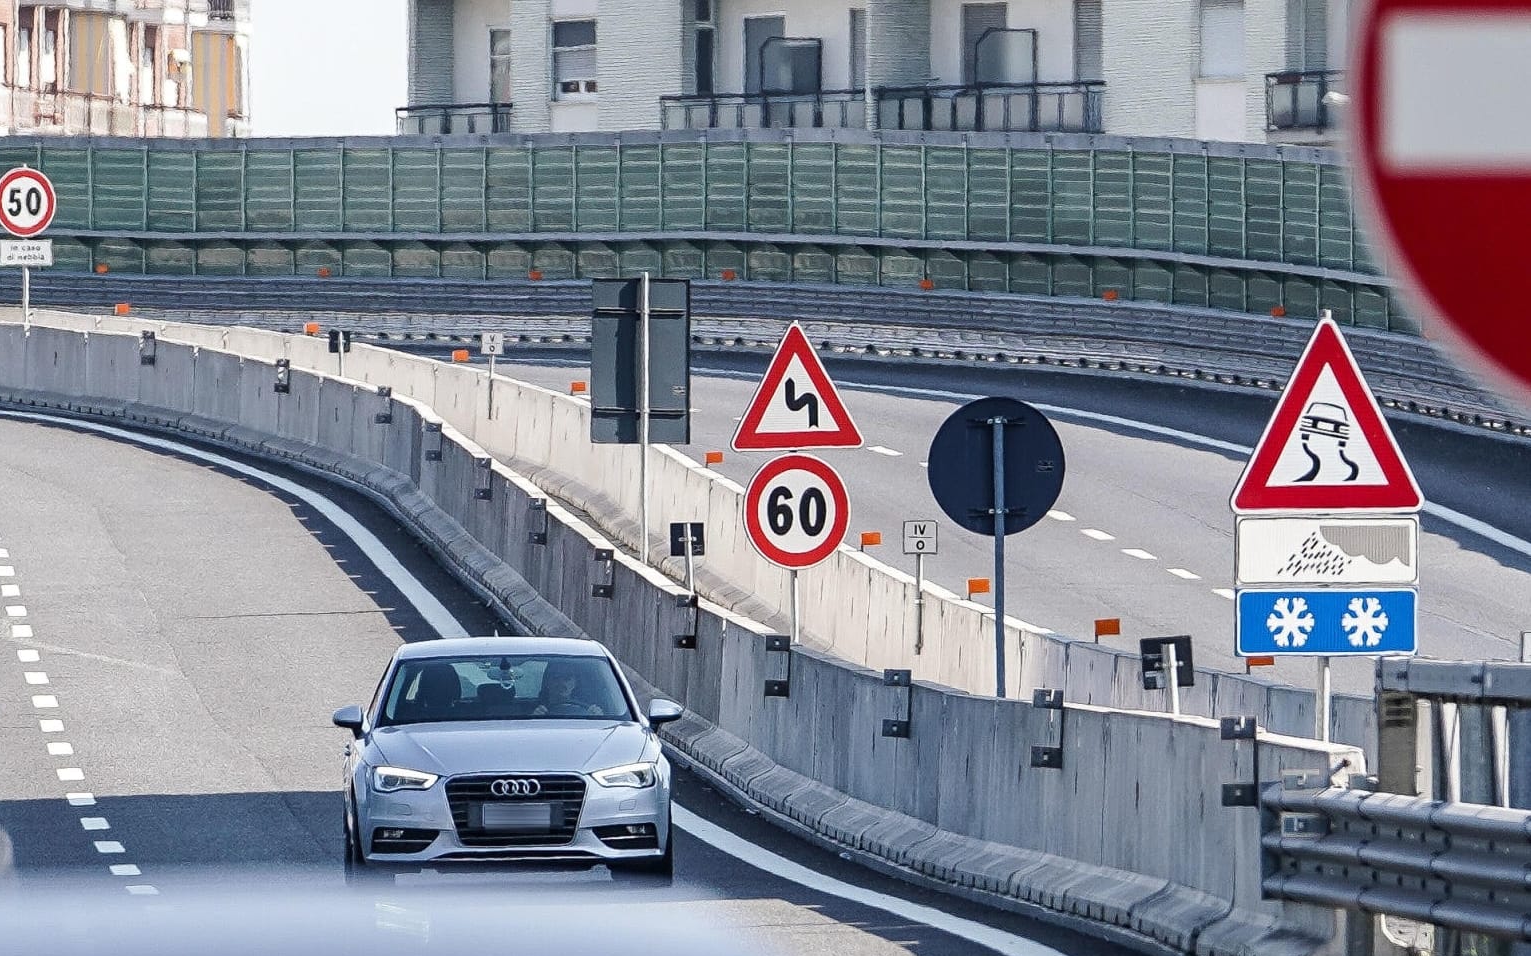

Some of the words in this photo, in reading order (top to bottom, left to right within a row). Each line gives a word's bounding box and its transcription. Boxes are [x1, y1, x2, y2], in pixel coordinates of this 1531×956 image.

[8, 187, 42, 217] 50
[767, 486, 827, 536] 60
[914, 524, 926, 535] IV
